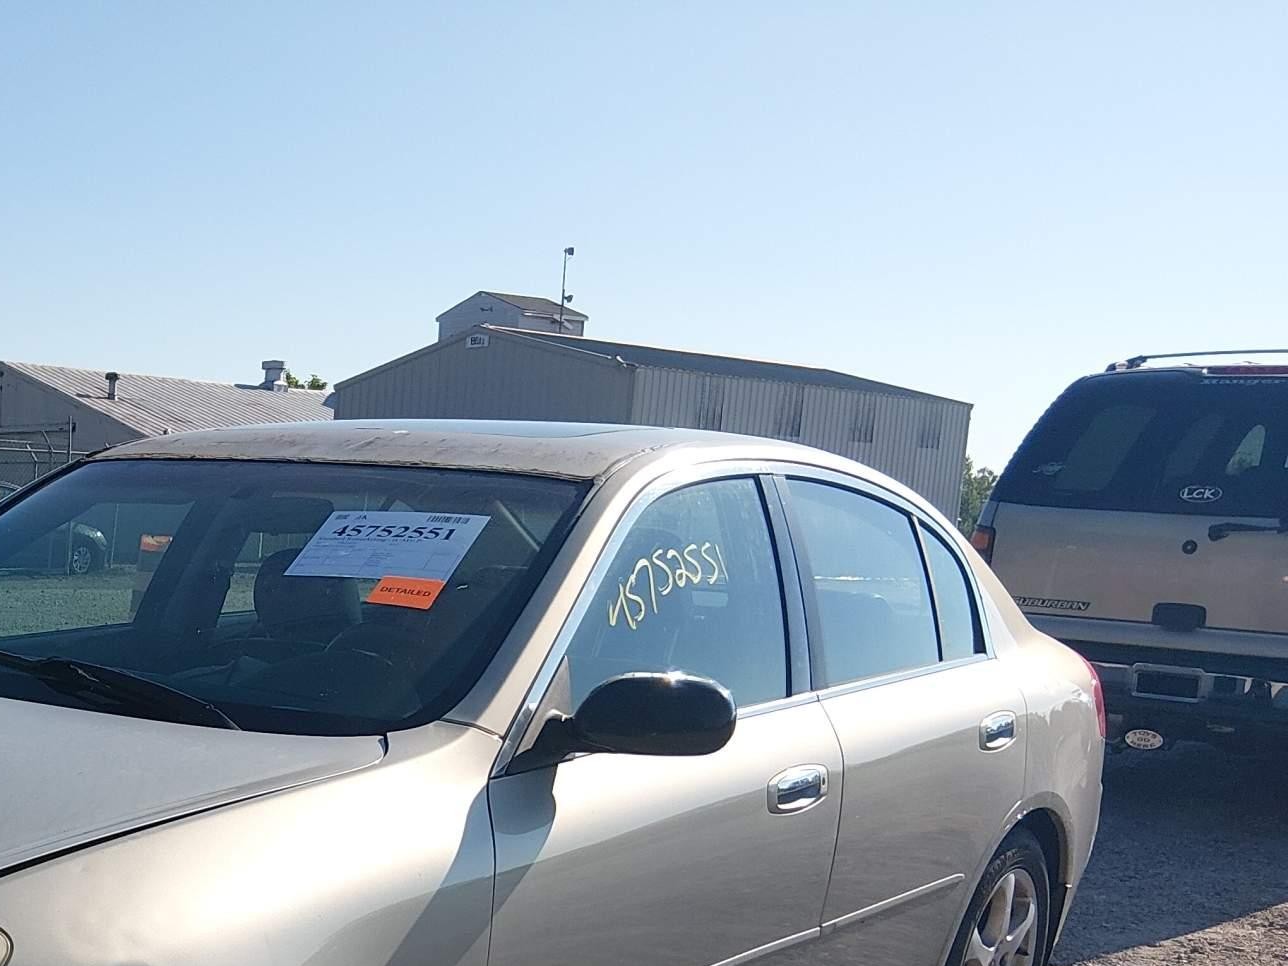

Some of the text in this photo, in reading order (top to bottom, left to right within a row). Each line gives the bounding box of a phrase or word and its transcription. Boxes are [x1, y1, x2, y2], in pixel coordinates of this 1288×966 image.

[1183, 488, 1215, 499] LCK
[332, 525, 456, 541] 45752551
[380, 586, 431, 597] DETAILED
[608, 541, 729, 630] 45752551
